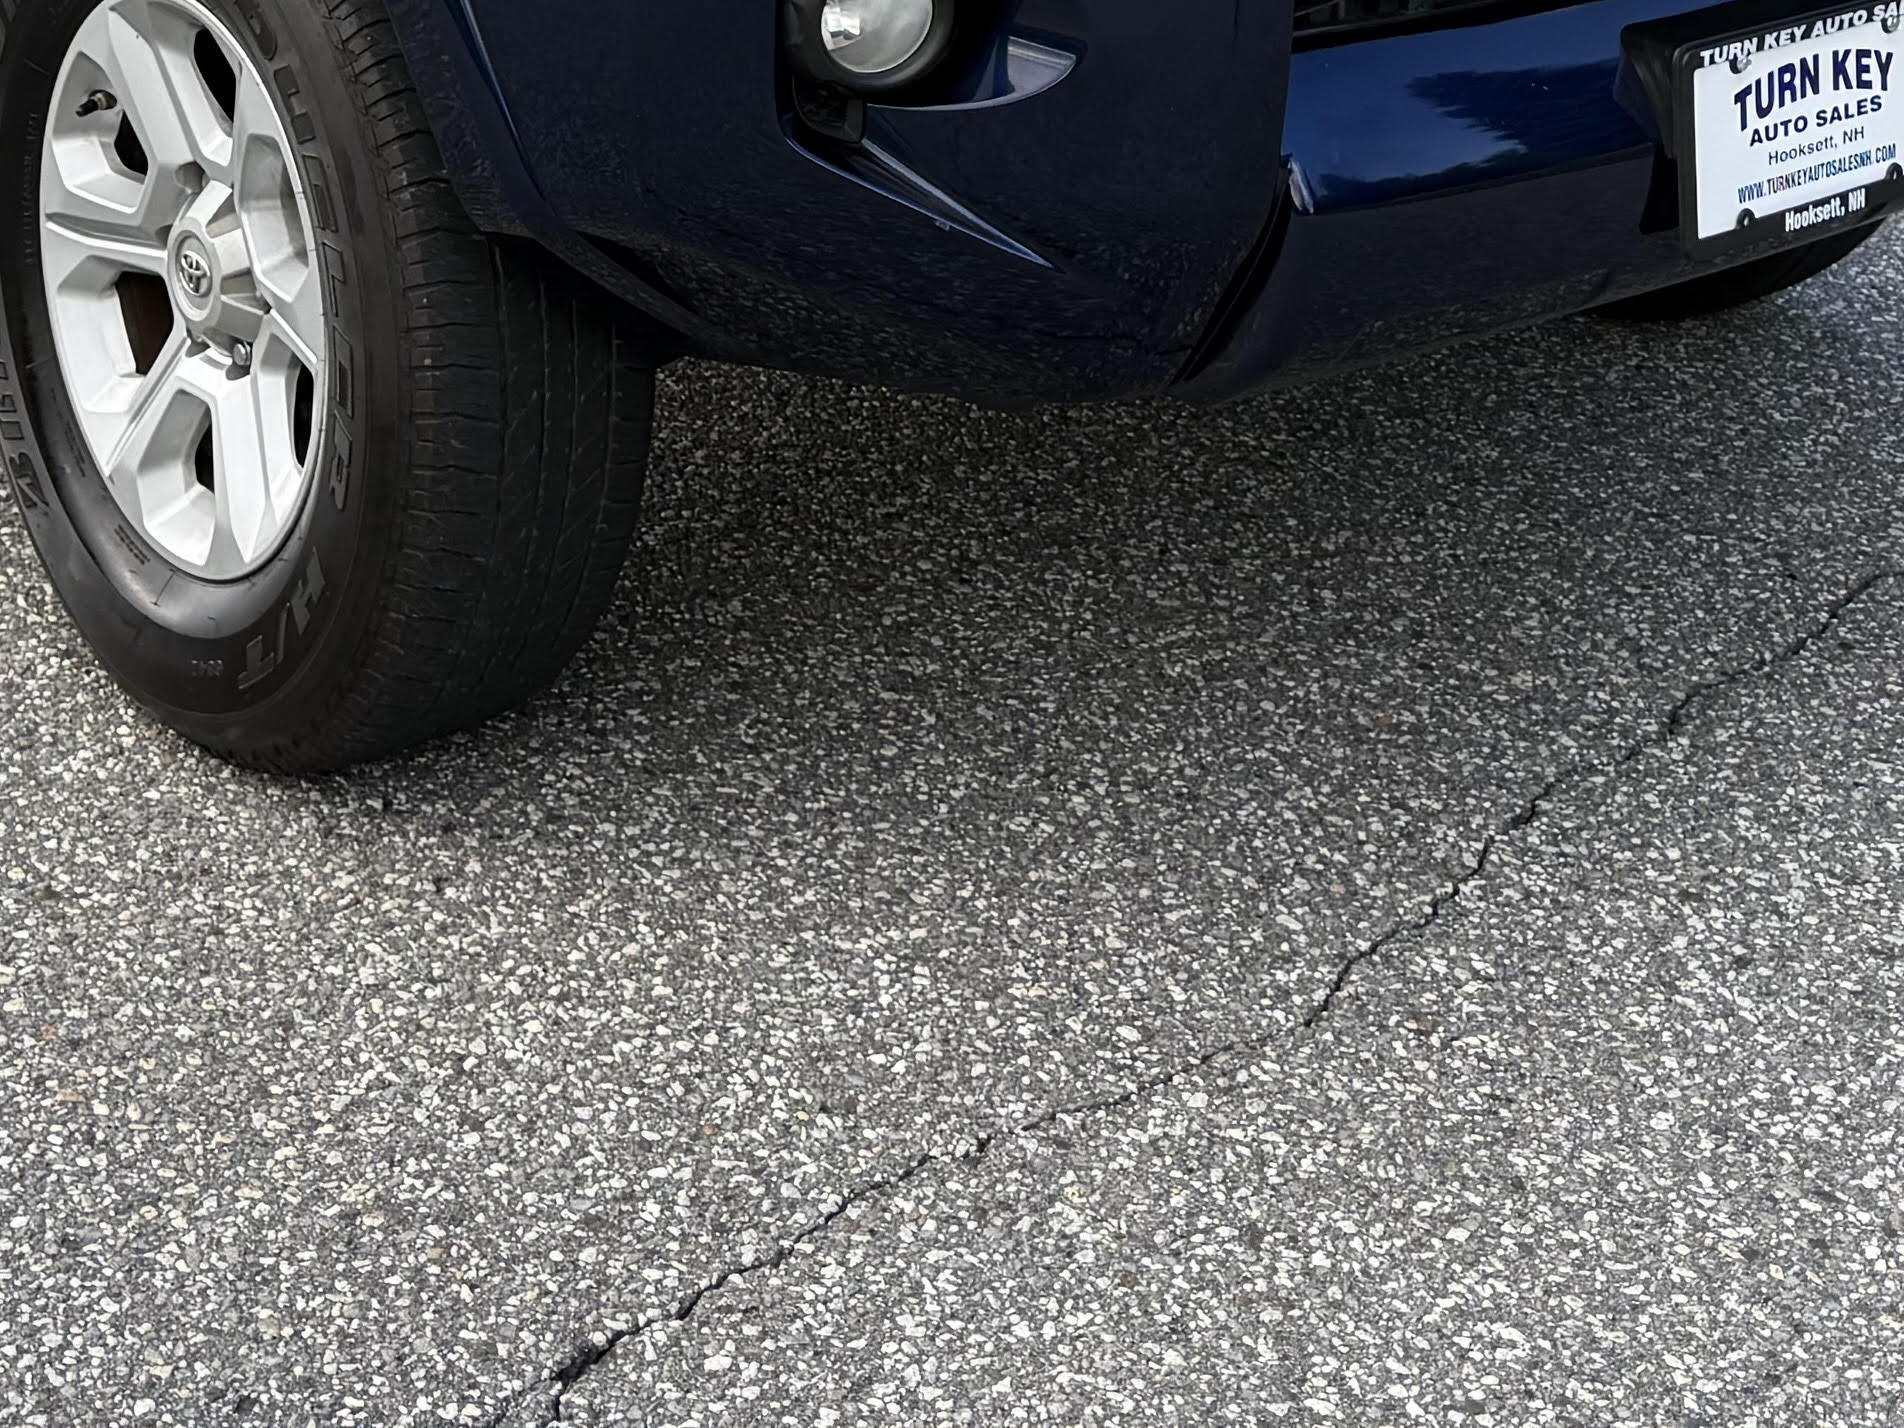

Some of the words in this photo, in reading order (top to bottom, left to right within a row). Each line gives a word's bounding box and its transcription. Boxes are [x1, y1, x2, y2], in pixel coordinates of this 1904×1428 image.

[1700, 38, 1759, 67] TURN
[1764, 25, 1807, 50] KEY
[1811, 10, 1868, 38] AUTO
[1733, 53, 1820, 134] TURN
[1832, 48, 1894, 92] KEY
[1749, 115, 1808, 147] AUTO
[1815, 95, 1882, 127] SALES
[1768, 135, 1837, 166] Hooksett,
[1843, 126, 1865, 145] NH
[1784, 196, 1845, 232] Hooksett,
[1848, 187, 1866, 213] NH
[237, 545, 327, 690] H/T
